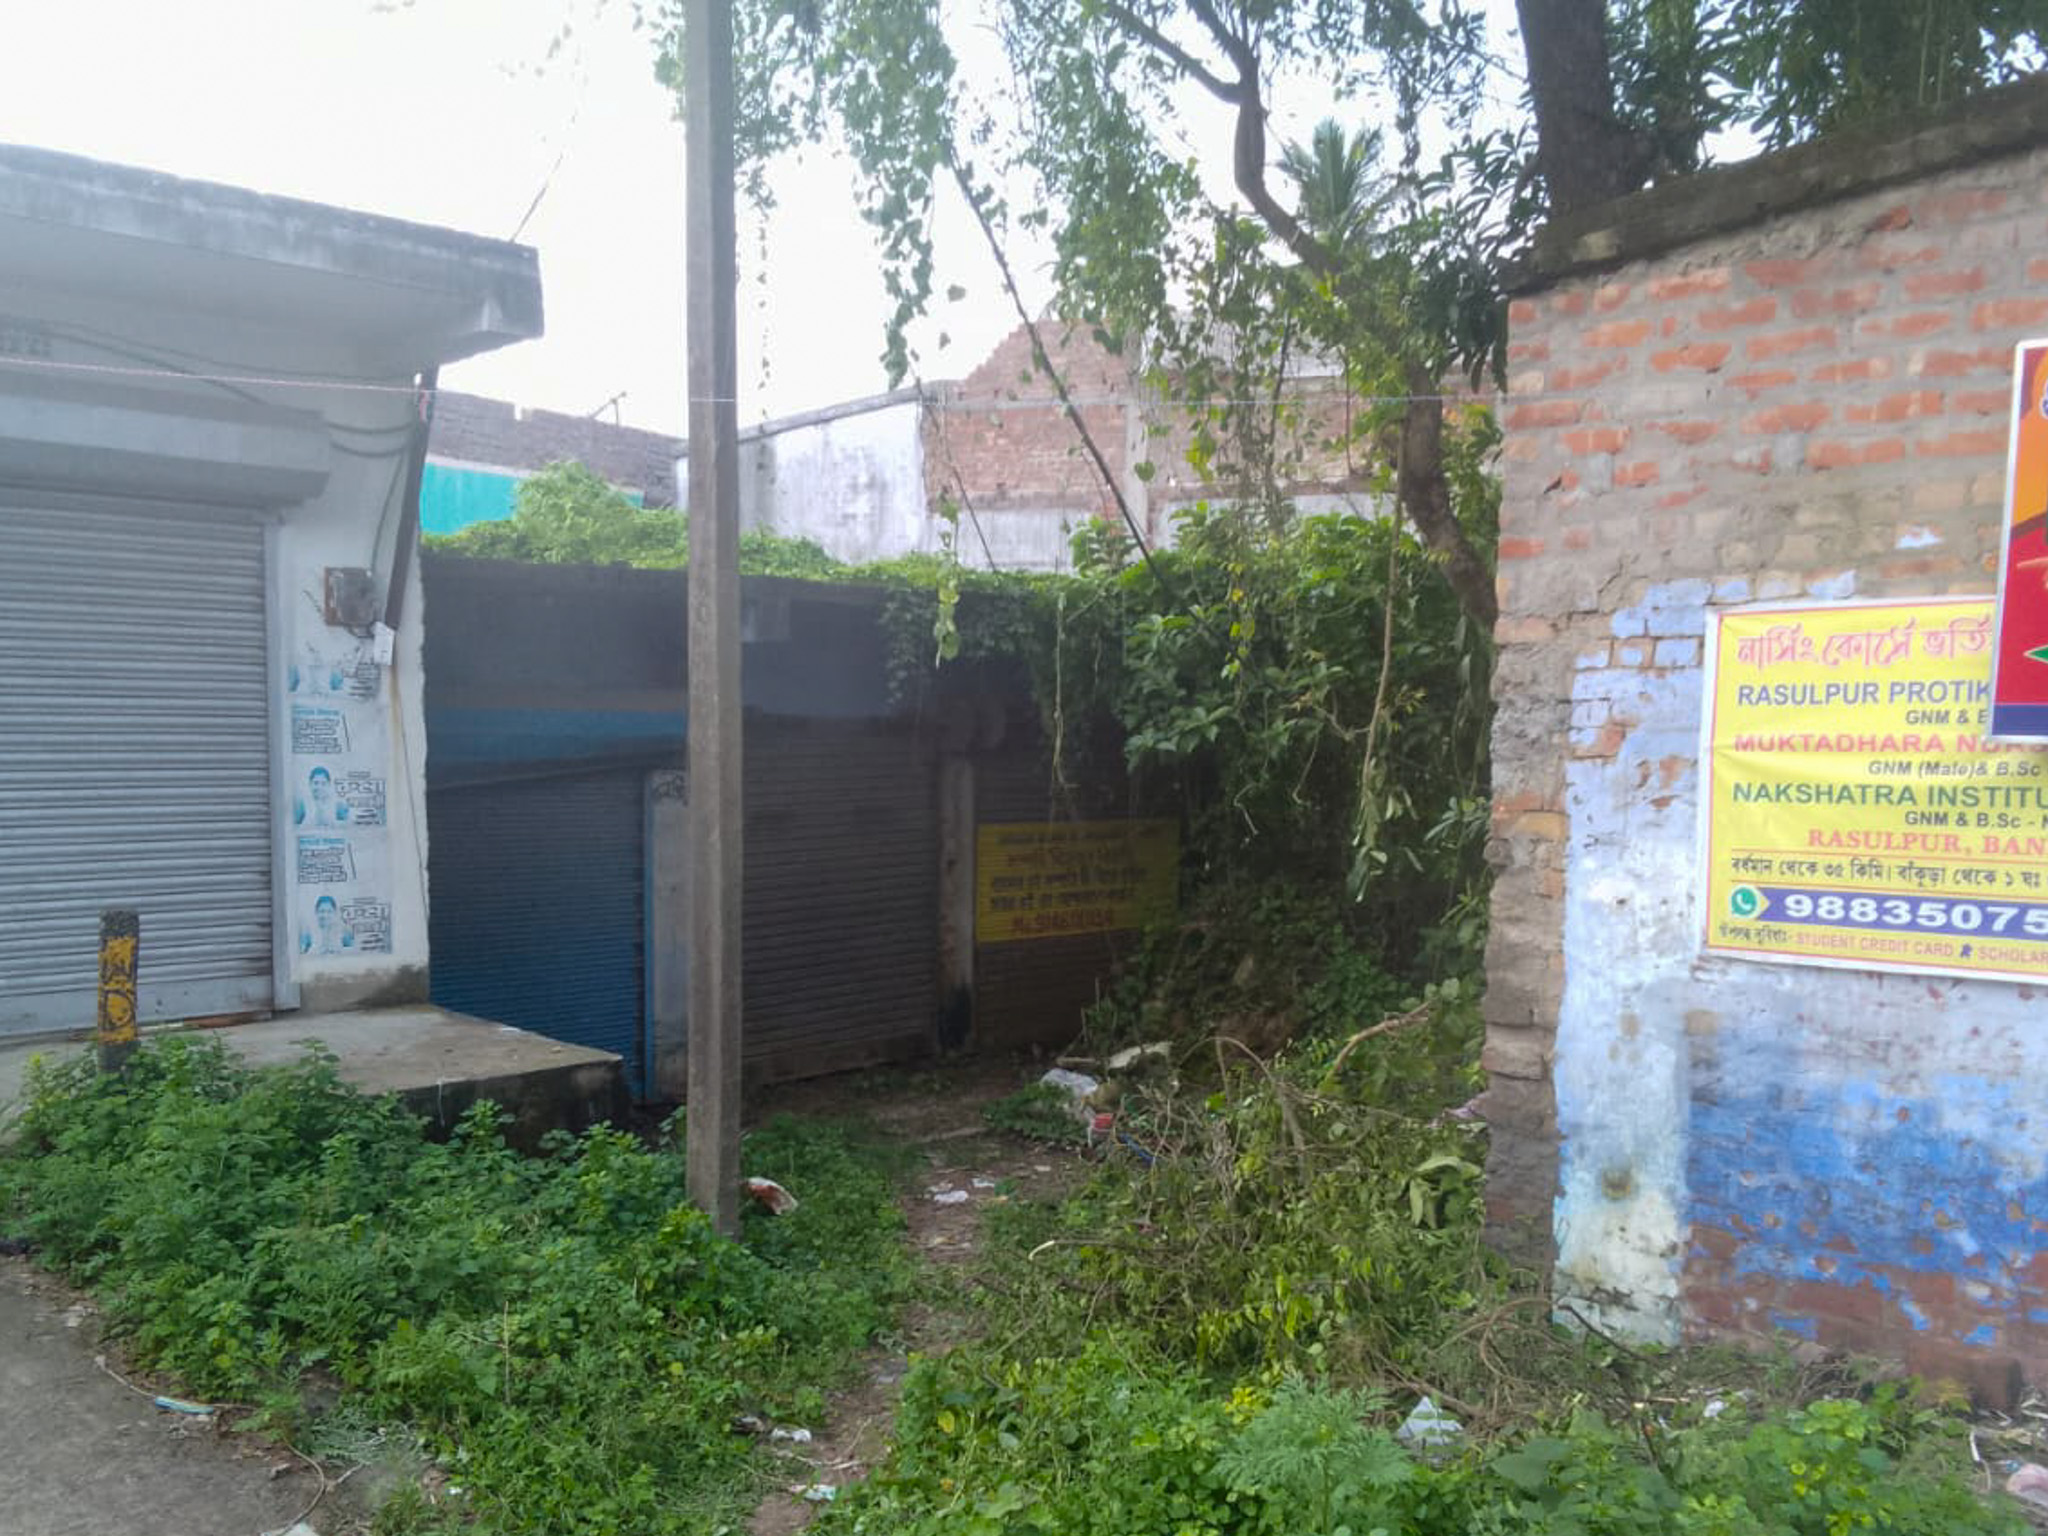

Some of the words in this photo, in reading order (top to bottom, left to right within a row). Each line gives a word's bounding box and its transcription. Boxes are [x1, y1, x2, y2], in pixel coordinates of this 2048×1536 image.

[1738, 623, 1815, 669] নার্সিং
[1822, 616, 1917, 667] কোর্সে
[1920, 614, 1992, 660] ভর্তি
[1737, 682, 1880, 706] RASULPUR
[1889, 679, 1991, 704] PROTIK
[1905, 709, 1950, 725] GNM
[1956, 710, 1970, 724] &
[1734, 733, 1945, 752] MUKTADHARA
[1868, 760, 1913, 775] GNM
[1995, 761, 2041, 777] B.Sc
[1733, 782, 1918, 806] NAKSHATRA
[1905, 811, 1950, 827] GNM
[1955, 812, 1969, 827] &
[1976, 813, 2021, 829] B.Sc
[1808, 828, 1973, 856] RASULPUR,
[1981, 834, 2047, 856] BAN
[1731, 856, 1773, 873] বর্ধমান
[1779, 859, 1817, 875] থেকে
[1953, 867, 1997, 886] থেকে
[1783, 893, 2048, 935] 98835075
[1797, 932, 1855, 949] STUDENT
[1861, 936, 1908, 953] CREDIT
[1914, 940, 1953, 957] CARD
[1978, 945, 2048, 965] SCHOLAR
